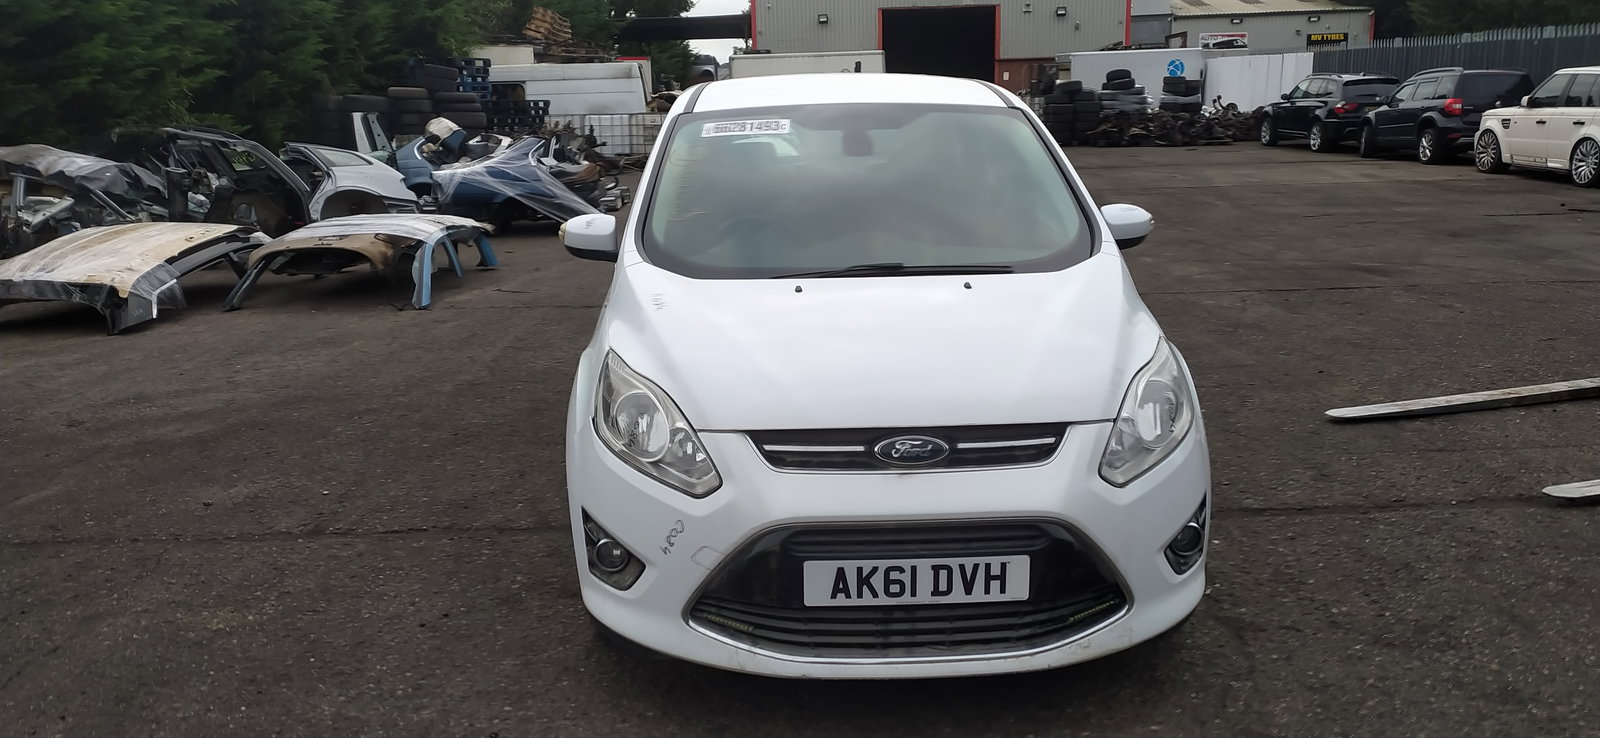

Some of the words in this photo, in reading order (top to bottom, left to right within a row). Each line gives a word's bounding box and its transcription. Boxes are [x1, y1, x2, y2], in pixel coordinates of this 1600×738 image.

[1322, 33, 1345, 41] TYRES
[892, 440, 933, 457] Ford
[830, 565, 918, 600] AK61
[931, 561, 1008, 597] DVH
